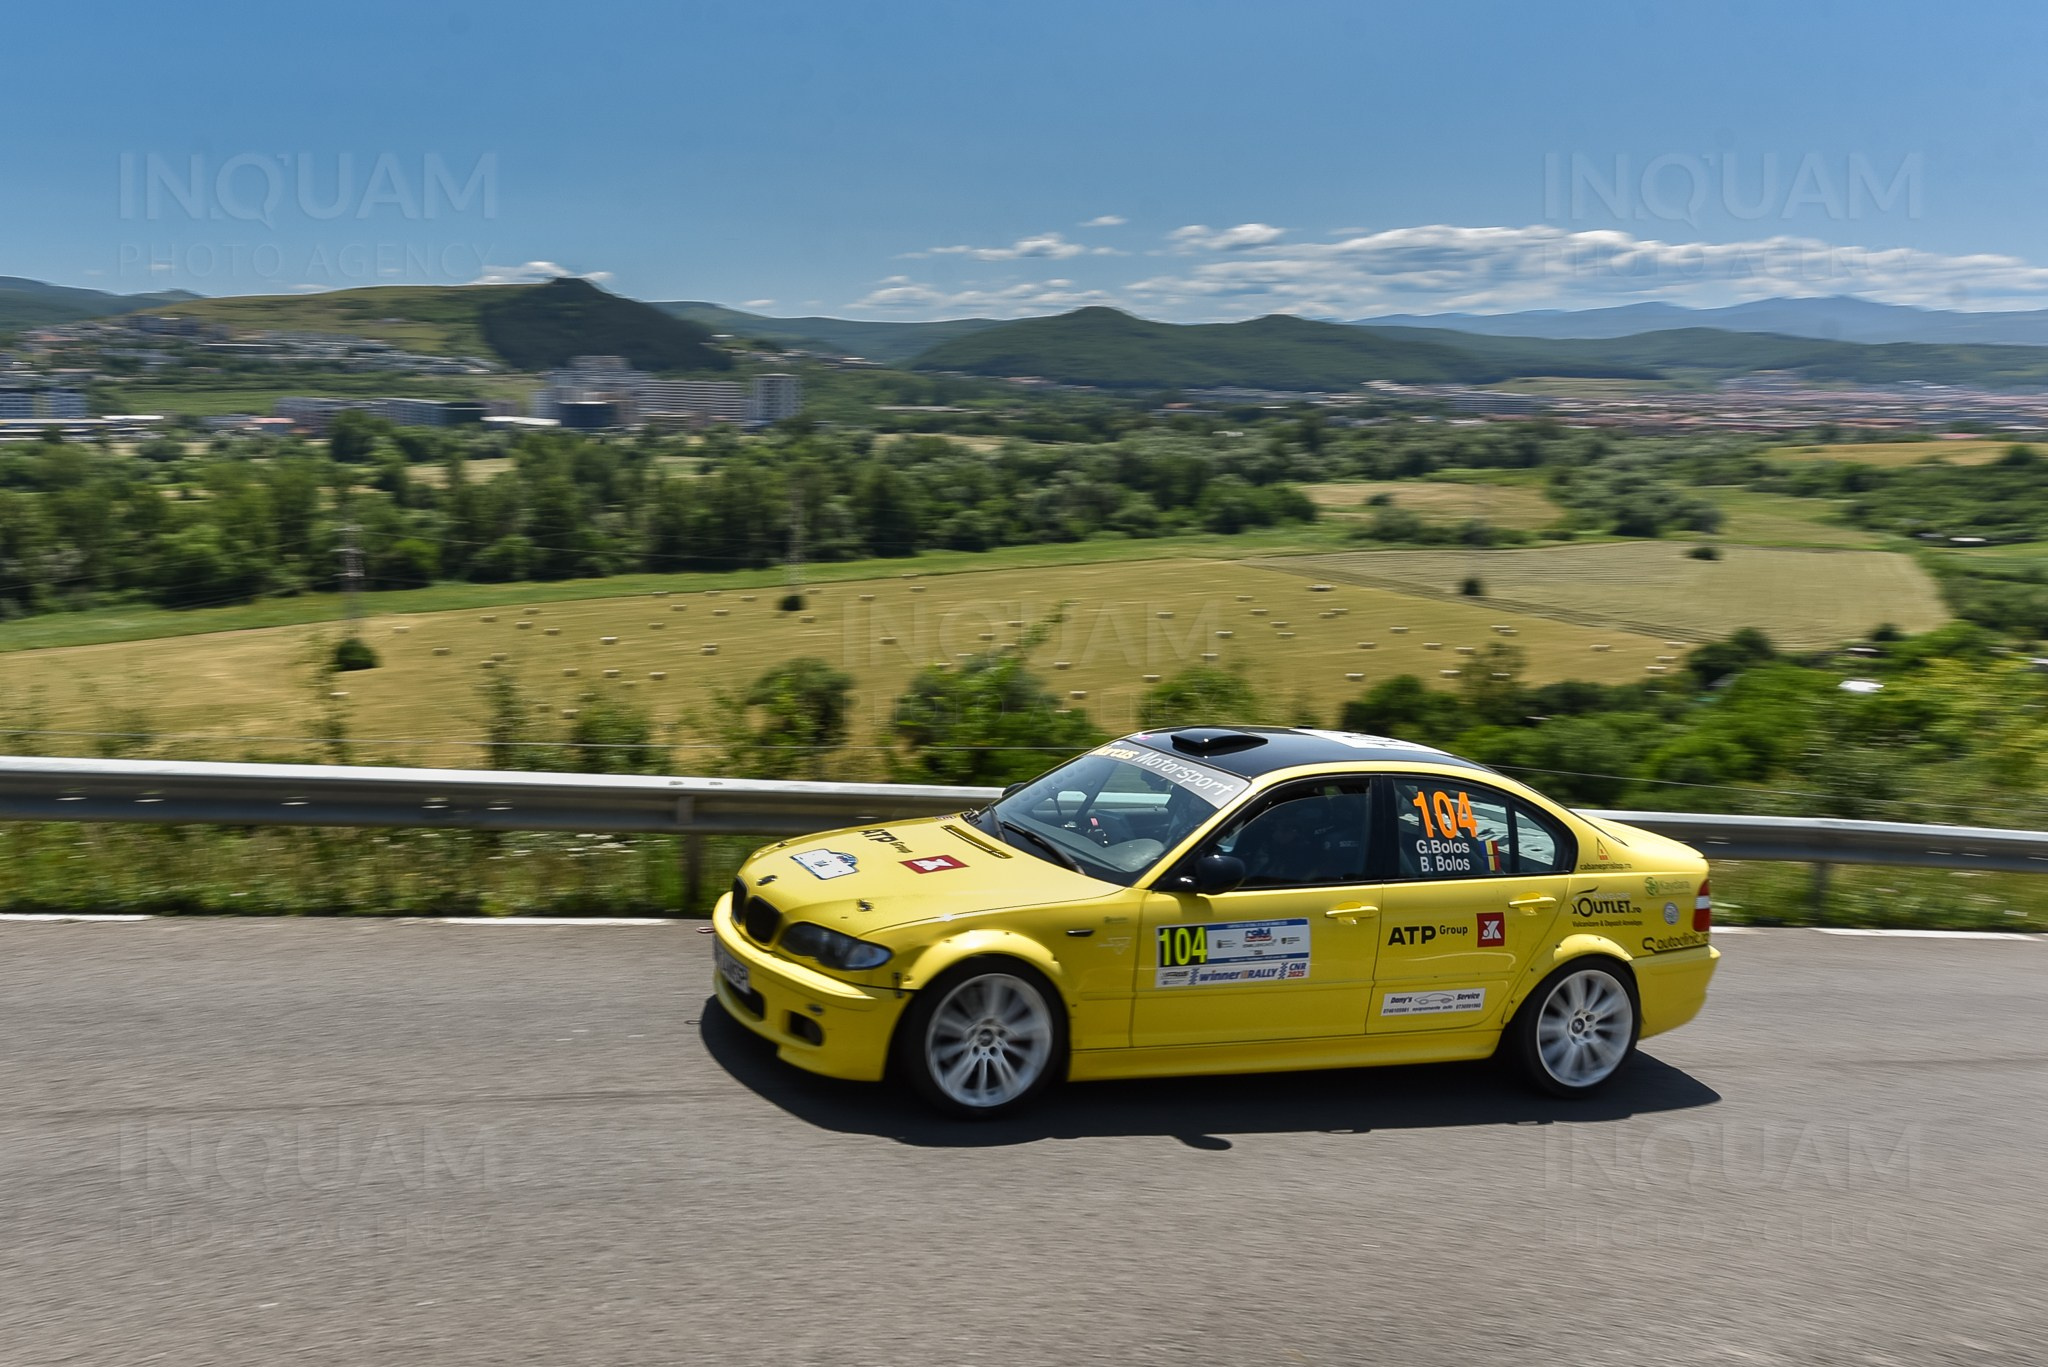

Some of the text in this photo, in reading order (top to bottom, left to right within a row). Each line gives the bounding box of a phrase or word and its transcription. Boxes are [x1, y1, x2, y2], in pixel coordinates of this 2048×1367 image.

[1132, 752, 1235, 796] Motorsport
[1412, 790, 1479, 840] 104
[857, 829, 899, 843] ATP
[1416, 840, 1470, 855] G.Bolos
[1420, 855, 1471, 872] B. Bolos
[1387, 925, 1468, 946] ATP Group
[1159, 926, 1208, 966] 104
[1287, 970, 1305, 978] 2025
[1289, 962, 1307, 971] CNR
[1198, 969, 1241, 982] winner
[1248, 967, 1279, 979] RALLY
[1456, 992, 1481, 1001] Service
